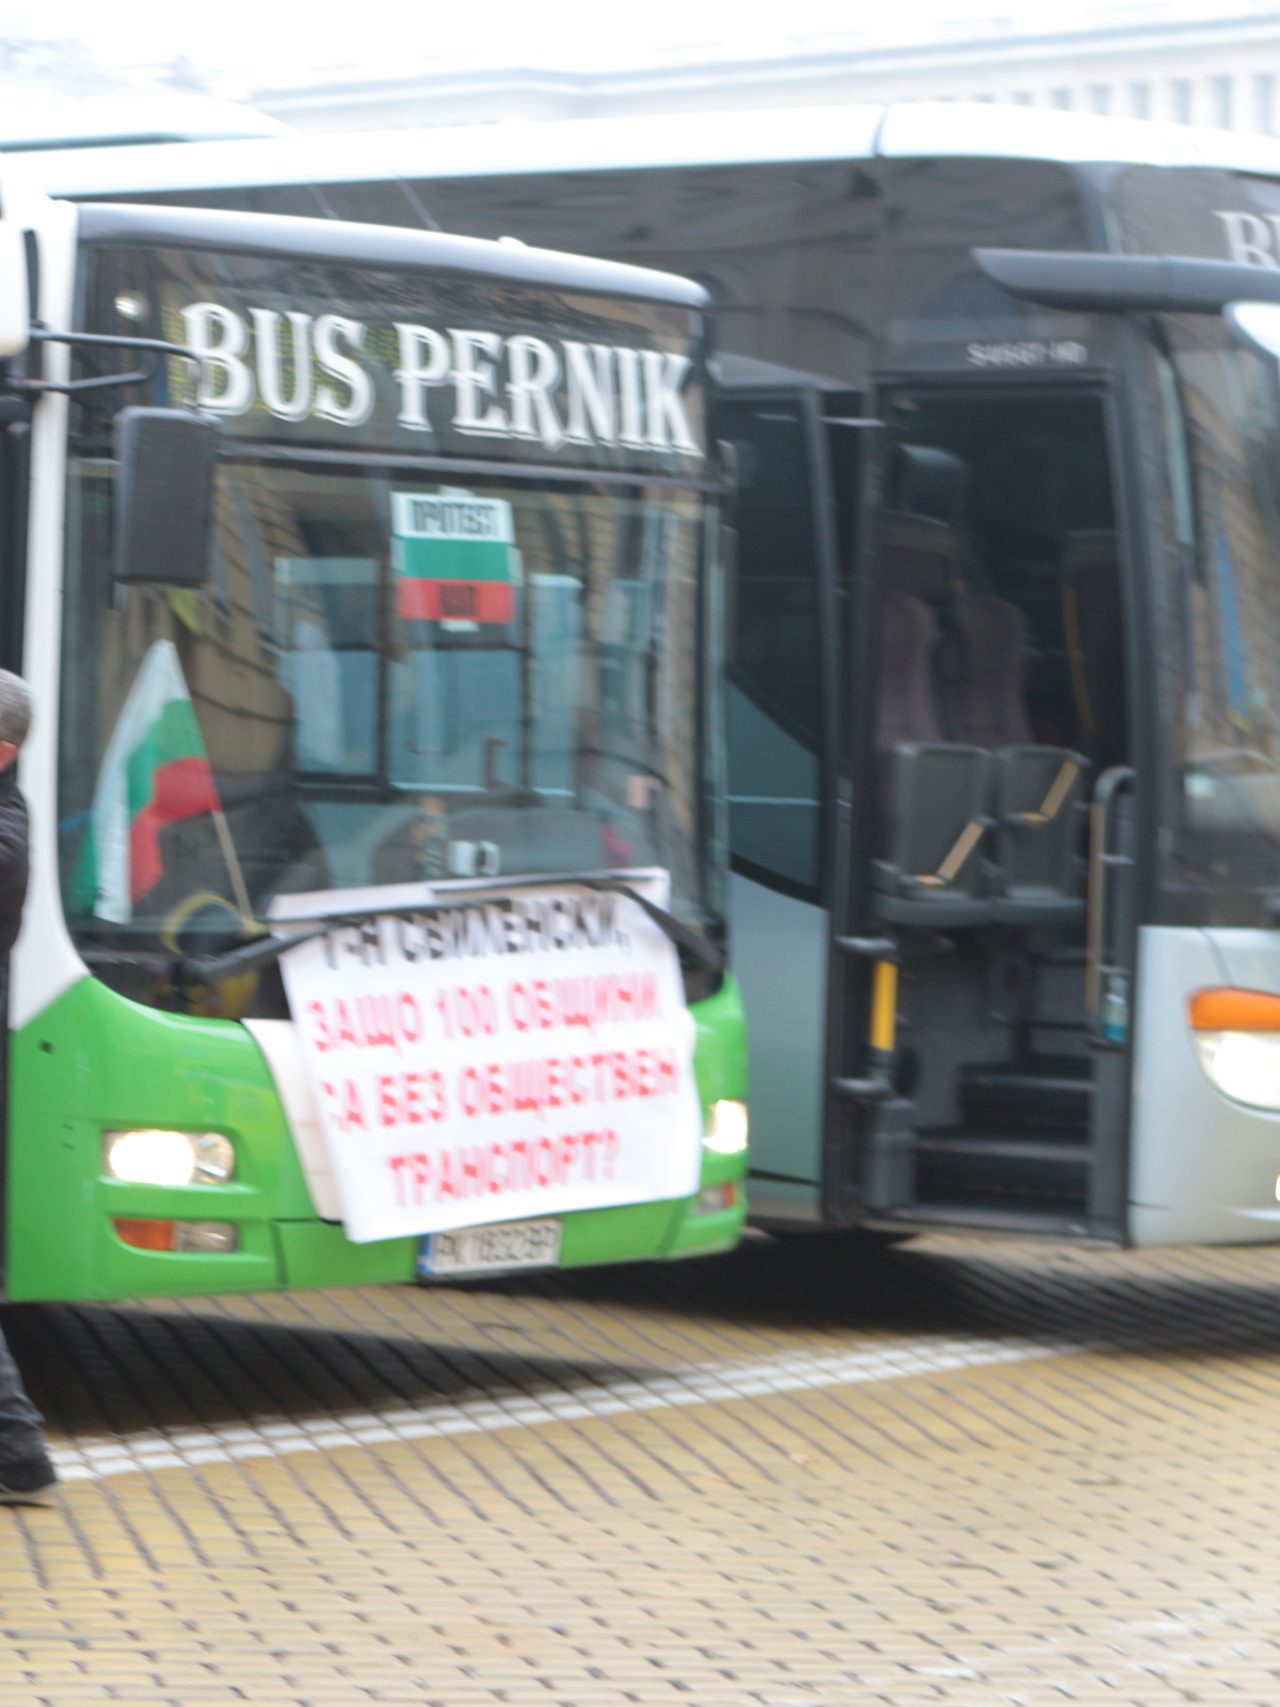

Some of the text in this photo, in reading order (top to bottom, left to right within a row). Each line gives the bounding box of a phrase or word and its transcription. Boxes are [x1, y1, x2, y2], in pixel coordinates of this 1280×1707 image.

[1212, 210, 1280, 272] B
[181, 302, 705, 456] BUS PERNIK
[310, 973, 662, 1056] ЗАЩО 100 ОБЩИНИ
[378, 1070, 447, 1127] БЕЗ
[460, 1050, 681, 1121] ОБЩЕСТВЕН
[385, 1128, 621, 1208] ТРАНСПОРТ?
